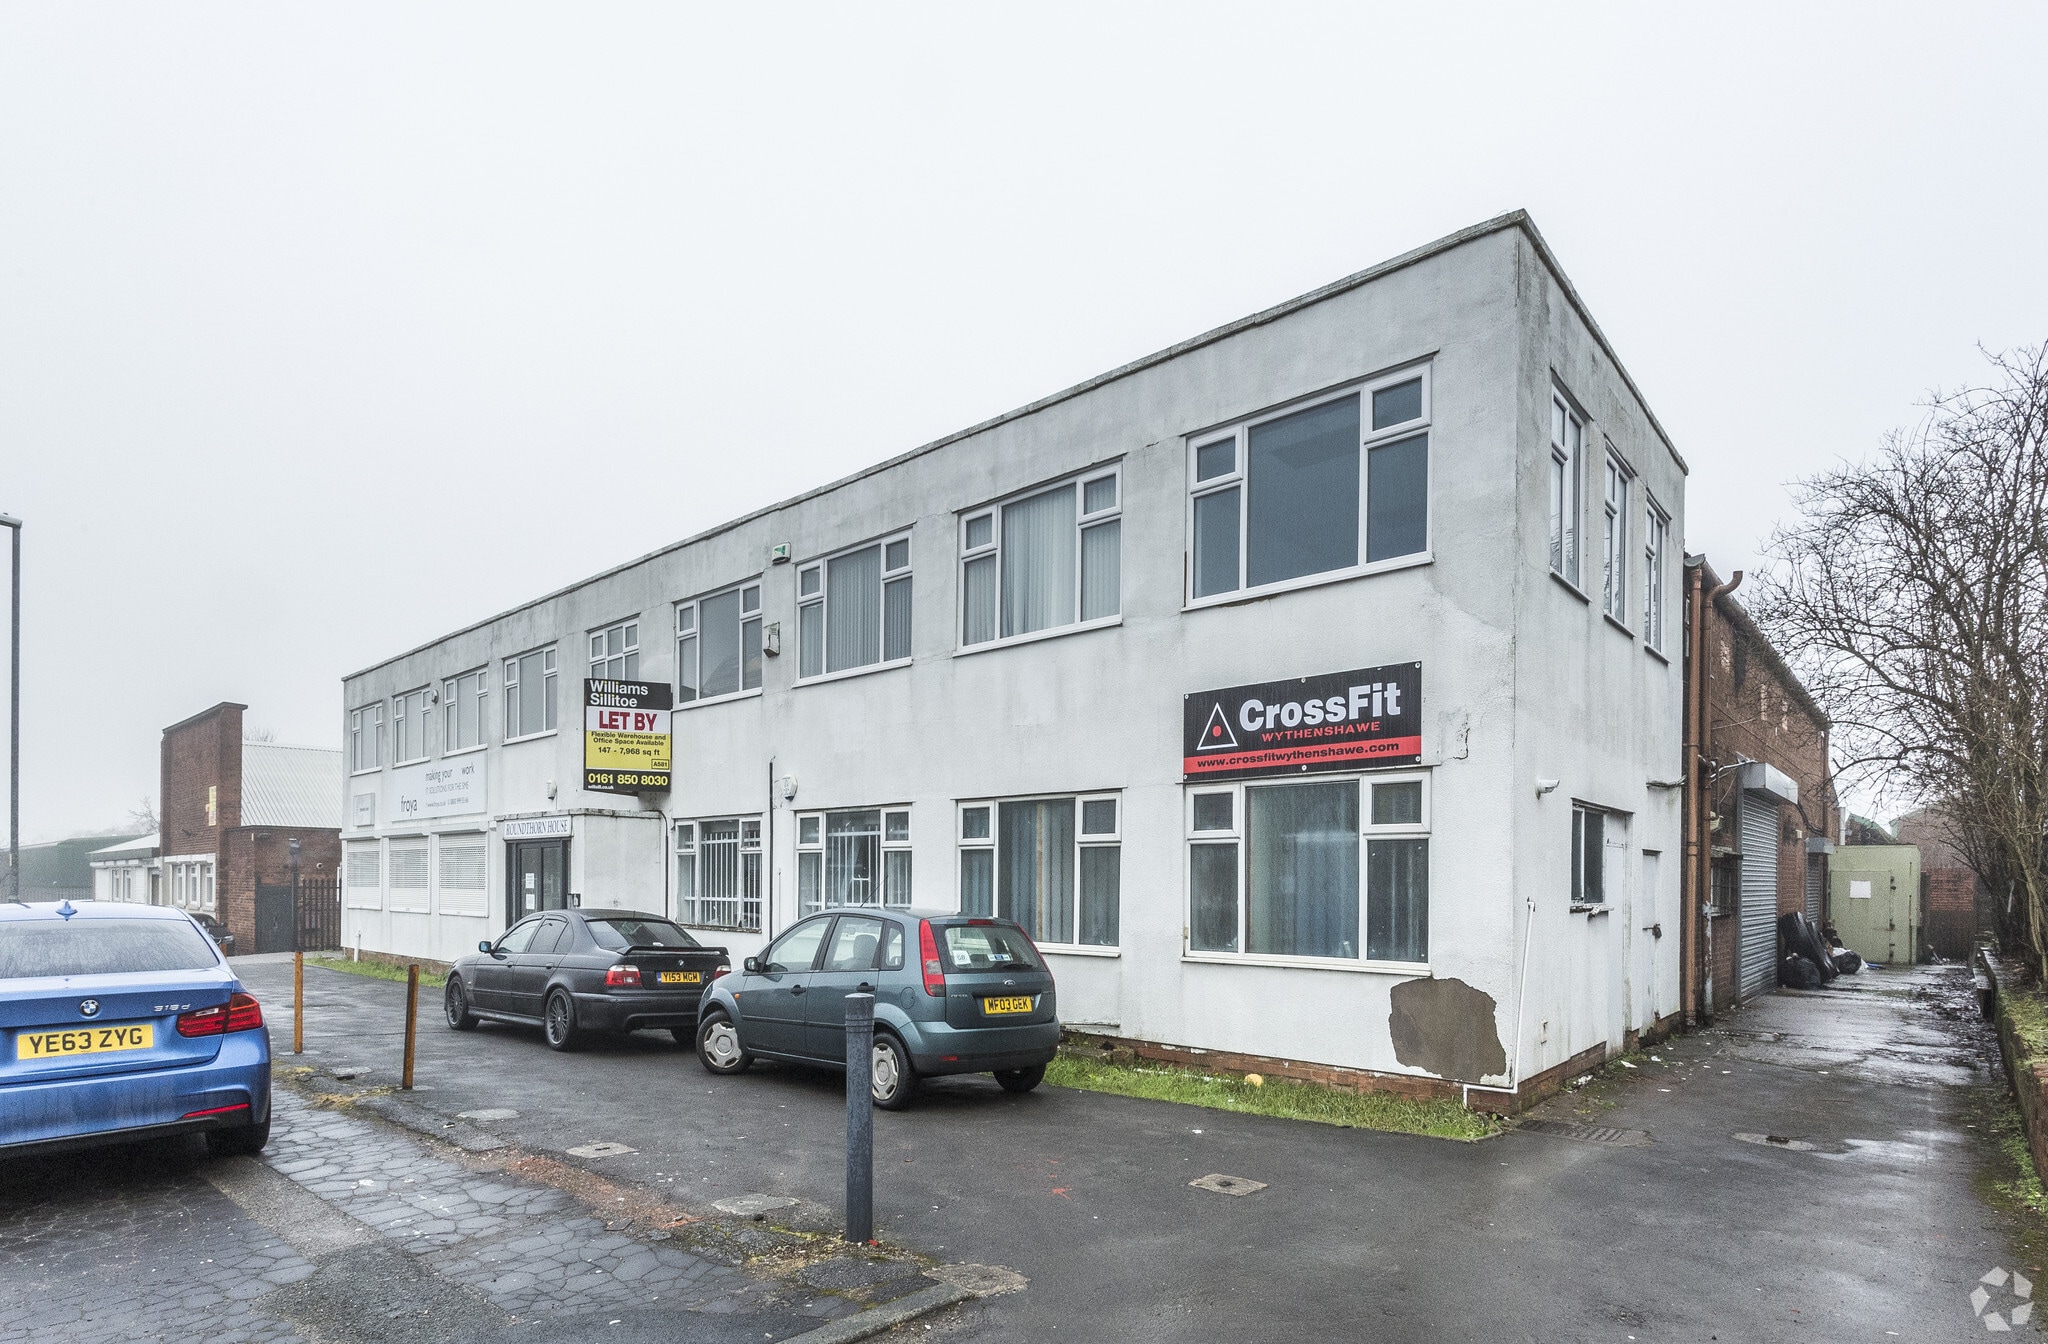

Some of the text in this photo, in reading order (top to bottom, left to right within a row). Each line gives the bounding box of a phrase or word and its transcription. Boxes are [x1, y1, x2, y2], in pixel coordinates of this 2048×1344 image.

[590, 680, 648, 696] Williams
[590, 693, 638, 707] Sillitoe
[1239, 682, 1401, 732] CrossFit
[599, 711, 658, 731] LET BY
[618, 732, 652, 740] Warehouse
[1261, 721, 1381, 742] WYTHENSHAWE
[615, 738, 634, 746] Space
[1197, 742, 1399, 768] www.crossfitwythenshawe.com
[425, 762, 475, 783] making your work
[588, 773, 668, 786] 0161 850 8030
[401, 795, 418, 817] froya
[506, 819, 568, 836] ROUNDTHORN HOUSE
[988, 996, 1028, 1011] MF03 GEK
[29, 1028, 143, 1055] YE63 ZYG
